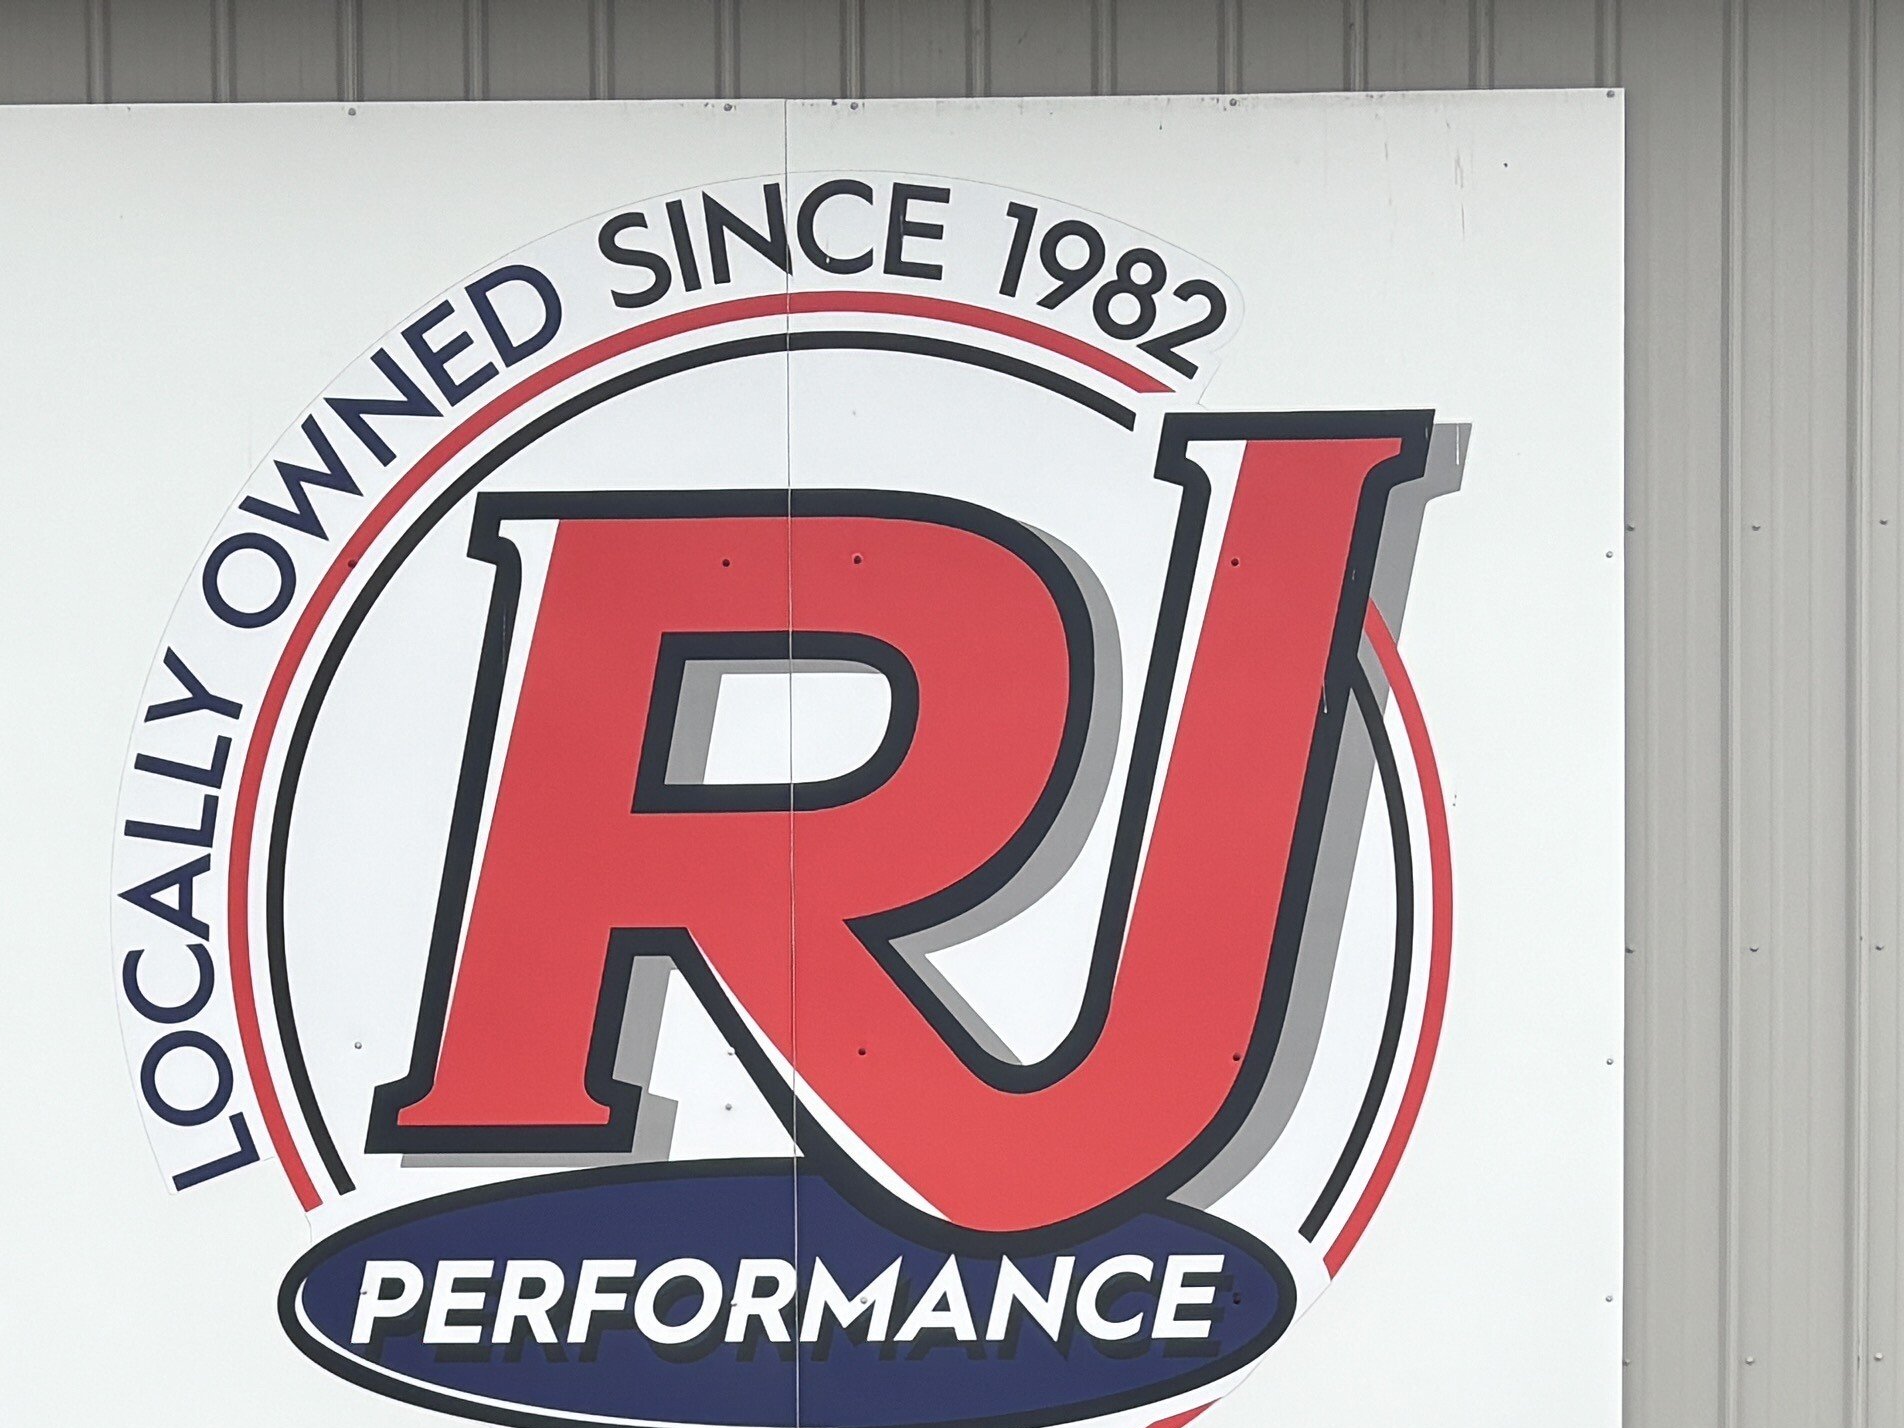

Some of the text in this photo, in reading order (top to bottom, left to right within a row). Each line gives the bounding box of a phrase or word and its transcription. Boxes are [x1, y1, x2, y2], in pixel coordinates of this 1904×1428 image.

[116, 178, 1227, 1192] LOCALLY OWNED SINCE 1982
[363, 407, 1436, 1252] RJ
[350, 1252, 1225, 1345] PERFORMANCE
